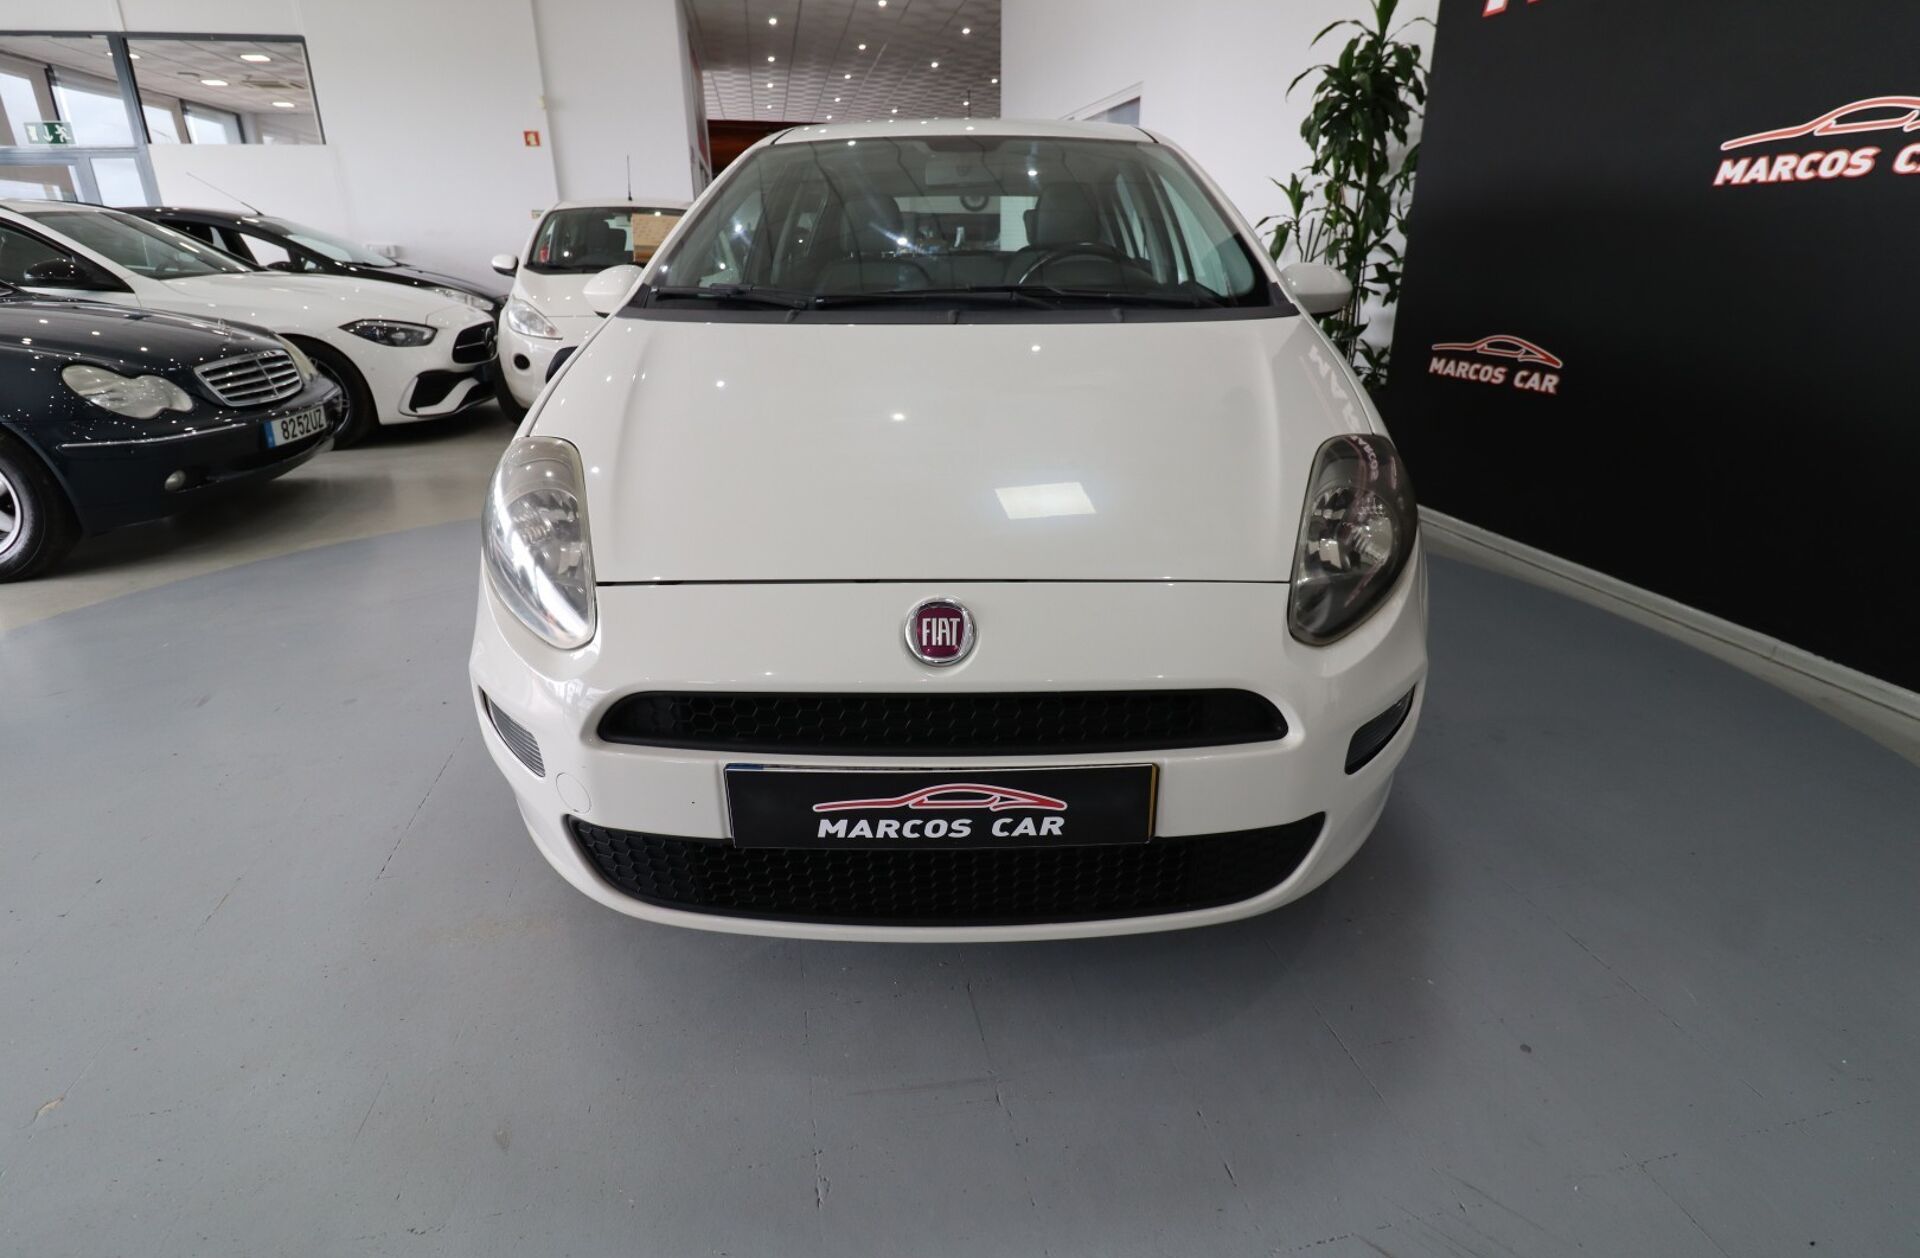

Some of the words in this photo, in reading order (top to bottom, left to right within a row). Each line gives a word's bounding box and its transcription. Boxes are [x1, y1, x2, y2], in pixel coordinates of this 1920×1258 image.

[1713, 146, 1881, 186] MARCOS
[1892, 142, 1920, 175] C
[1428, 357, 1508, 384] MARCOS
[1513, 370, 1560, 395] CAR
[281, 408, 324, 441] 8252UZ
[921, 617, 961, 646] FIAT
[817, 818, 972, 839] MARCOS
[991, 816, 1066, 837] CAR
